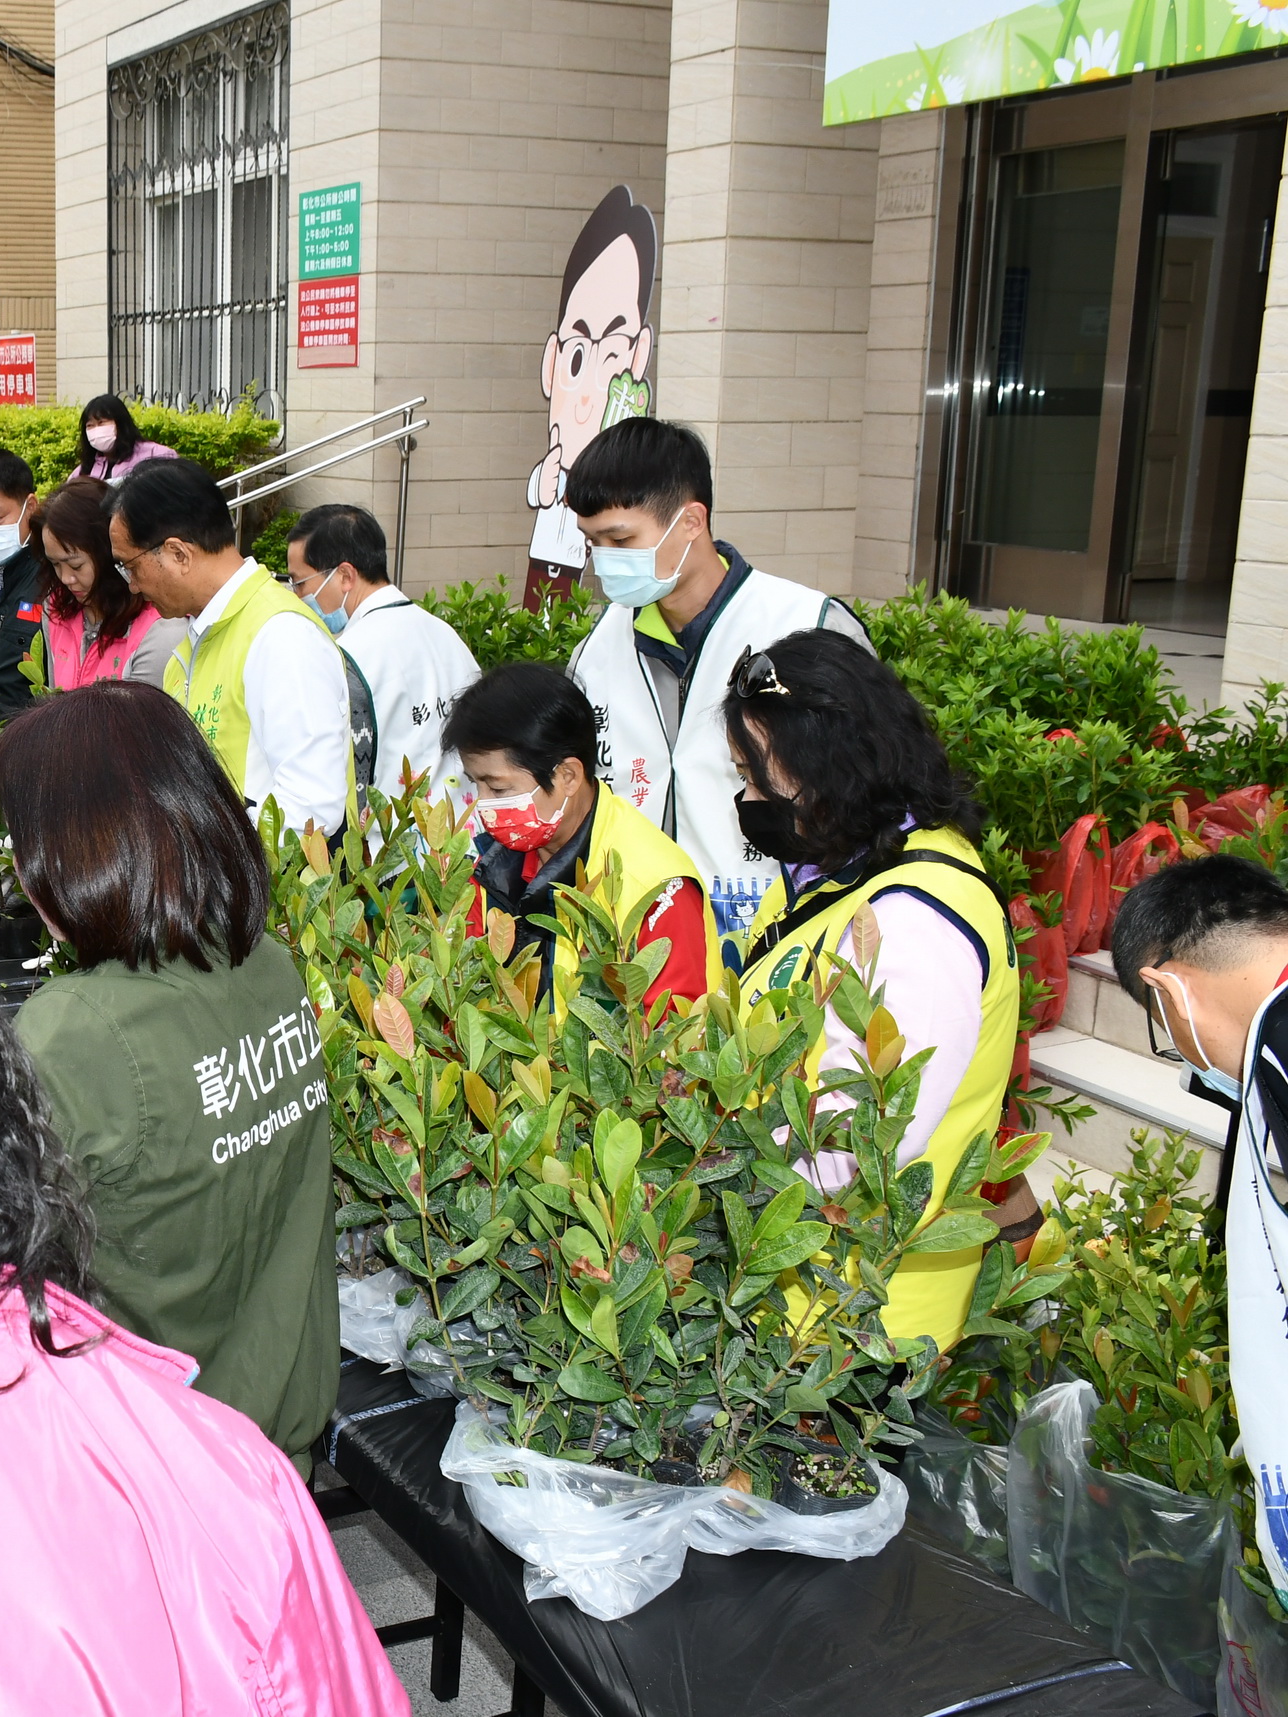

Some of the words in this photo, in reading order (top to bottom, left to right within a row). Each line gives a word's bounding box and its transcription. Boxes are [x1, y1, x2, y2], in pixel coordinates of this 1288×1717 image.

[193, 995, 323, 1119] 彰化市公
[212, 1100, 302, 1164] Changhua
